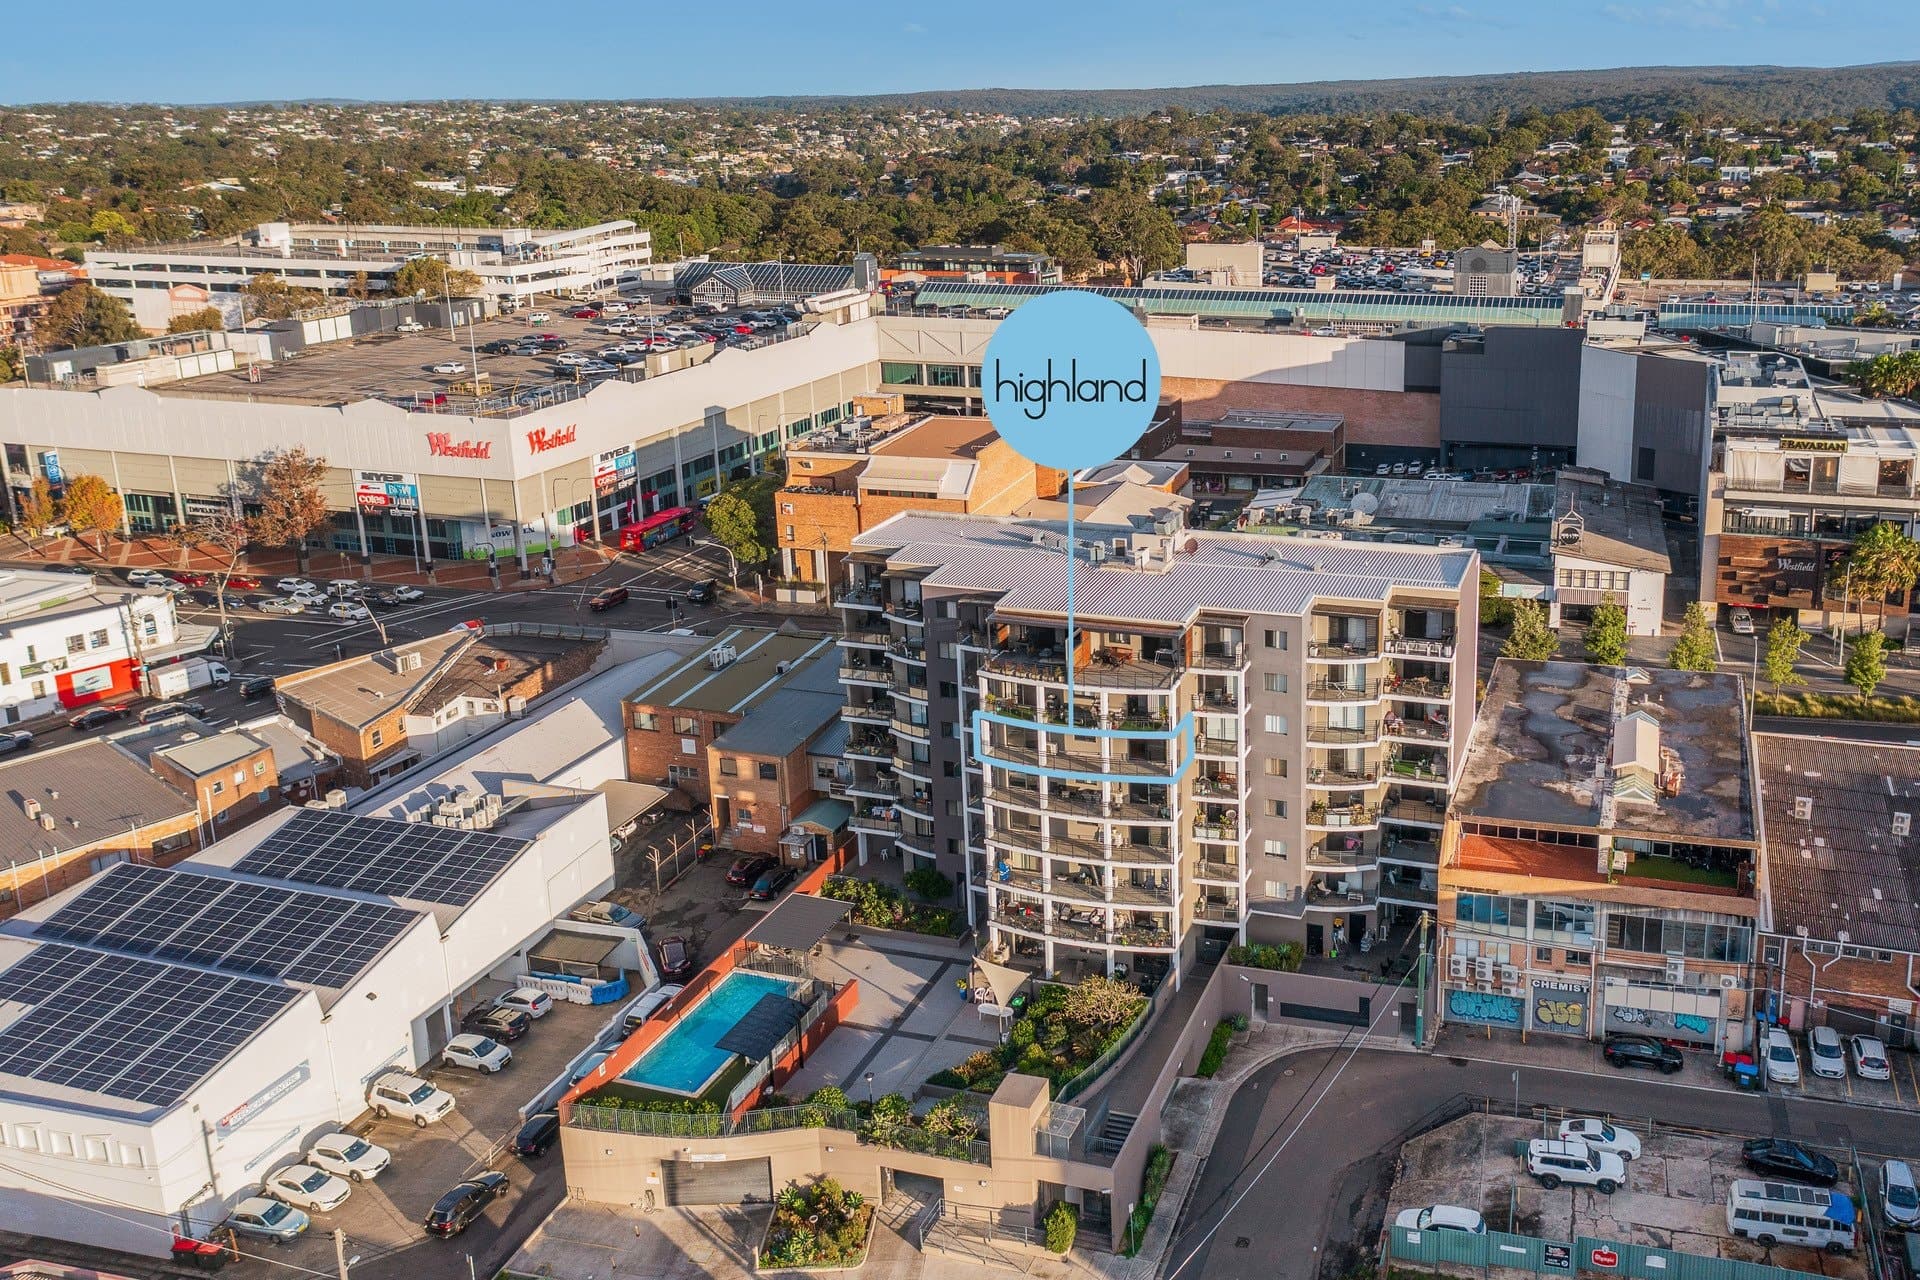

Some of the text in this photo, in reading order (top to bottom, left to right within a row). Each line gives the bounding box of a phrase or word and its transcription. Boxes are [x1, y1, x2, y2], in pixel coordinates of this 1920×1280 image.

[425, 432, 492, 459] Westfield
[527, 424, 577, 456] Westfield
[1788, 440, 1846, 451] BAVARIAN
[600, 446, 630, 462] MYER
[361, 472, 403, 482] MYER
[358, 494, 386, 506] coles
[1777, 558, 1816, 572] Westfield
[1532, 979, 1589, 993] CHEMIST
